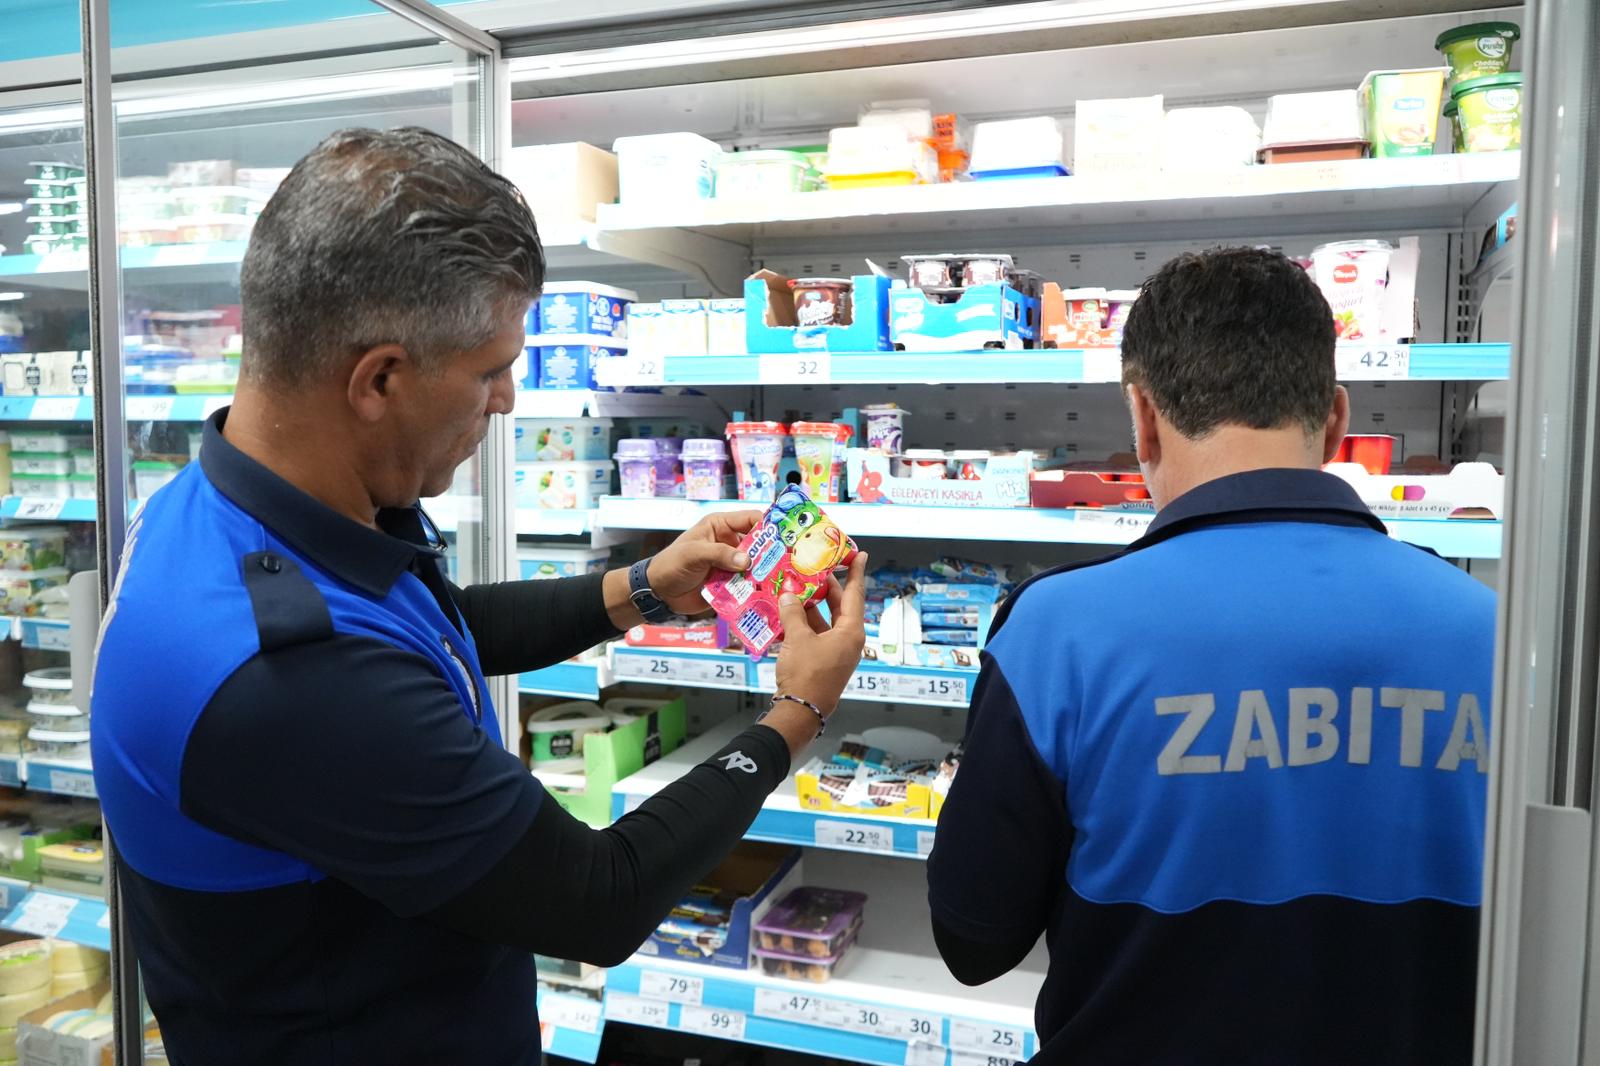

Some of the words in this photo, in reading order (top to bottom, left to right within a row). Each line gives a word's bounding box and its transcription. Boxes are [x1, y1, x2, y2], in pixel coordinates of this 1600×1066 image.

[1360, 351, 1389, 367] 42
[797, 361, 818, 375] 32
[747, 524, 777, 571] anino
[650, 660, 669, 673] 25
[716, 665, 735, 678] 25
[857, 676, 876, 690] 15
[929, 680, 949, 694] 15
[1155, 687, 1489, 775] ZABITA
[845, 829, 866, 844] 22
[669, 978, 688, 993] 79
[789, 996, 810, 1011] 47
[711, 1012, 730, 1028] 99
[859, 1010, 879, 1026] 30
[910, 1018, 931, 1035] 30
[991, 1029, 1014, 1046] 25
